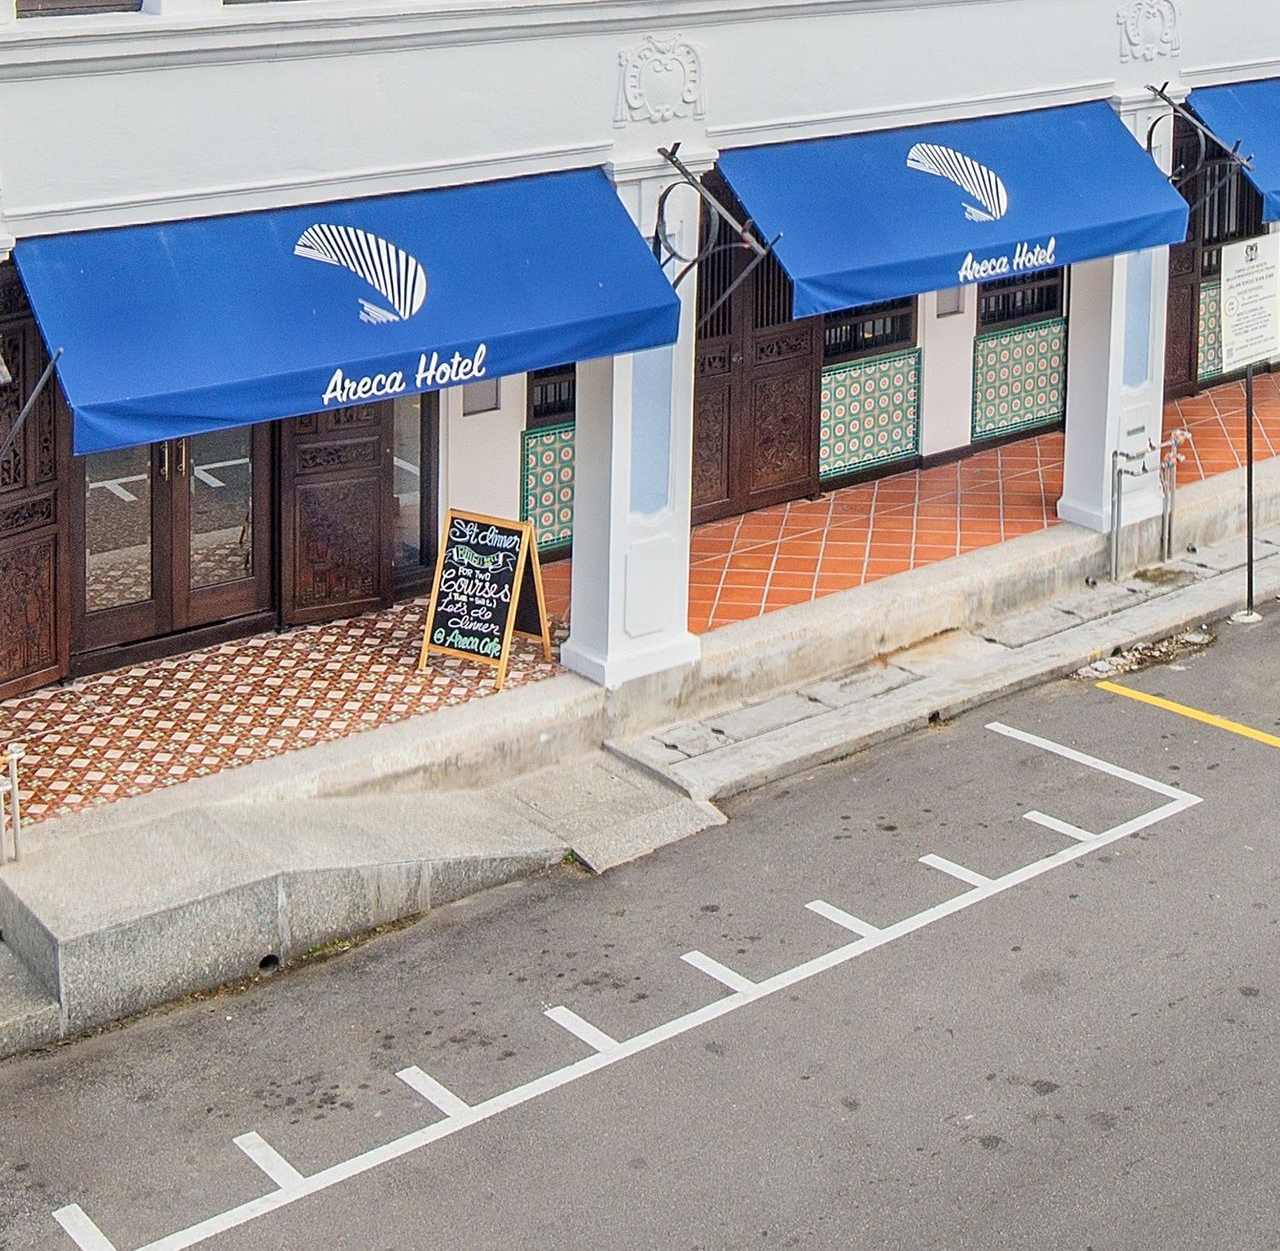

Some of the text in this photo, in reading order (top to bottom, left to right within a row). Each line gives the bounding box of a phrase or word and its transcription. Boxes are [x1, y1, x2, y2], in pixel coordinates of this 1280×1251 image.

[958, 236, 1056, 283] Areca Hotel
[321, 343, 488, 405] Areca Hotel
[449, 519, 520, 551] Set dinner
[440, 569, 511, 603] Courses
[458, 567, 491, 580] FOR TWO
[437, 597, 467, 615] Let's
[448, 615, 501, 635] dinner
[434, 628, 501, 658] @ Areca Cafe
